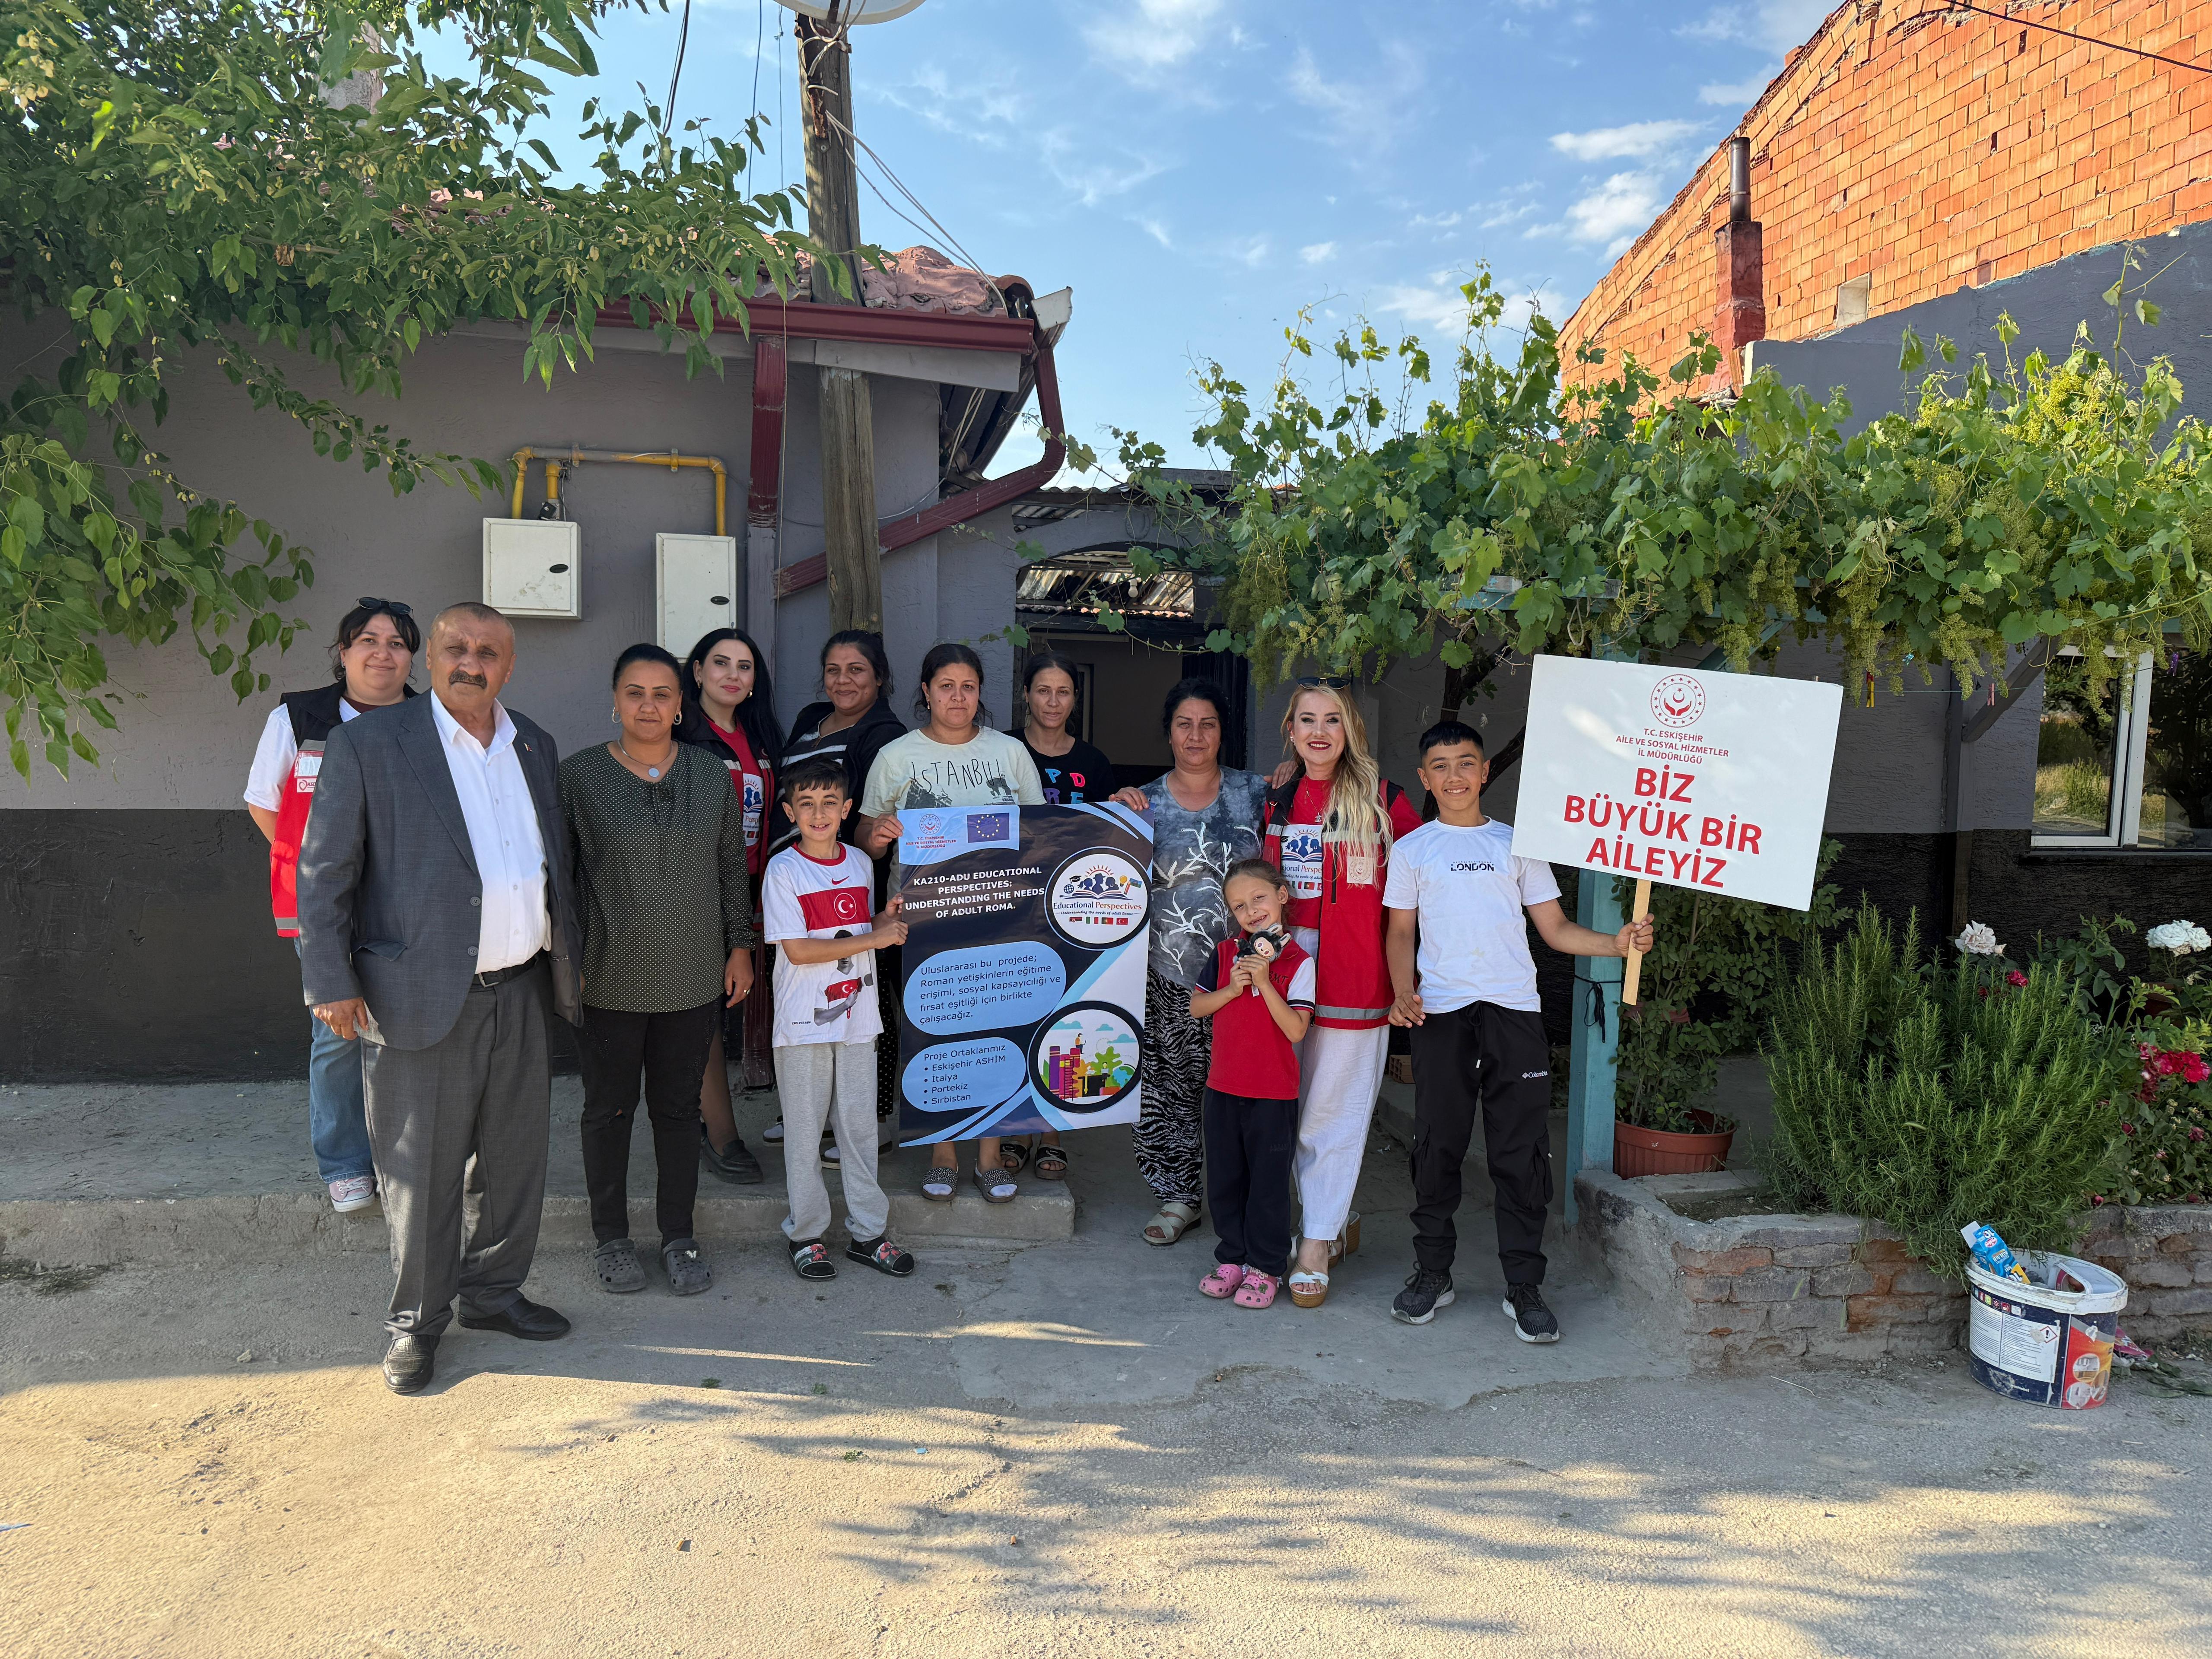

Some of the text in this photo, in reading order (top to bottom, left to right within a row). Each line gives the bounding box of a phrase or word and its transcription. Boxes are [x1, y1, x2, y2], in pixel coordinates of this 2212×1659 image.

[1659, 731, 1703, 742] ESKİŞEHİR
[1616, 735, 1633, 744] AİLE
[1647, 740, 1679, 750] SOSYAL
[1681, 744, 1729, 757] HİZMETLER
[1638, 748, 1702, 764] İL MÜDÜRLÜĞÜ
[1045, 769, 1085, 787] P D
[1635, 765, 1694, 803] BİZ
[1043, 788, 1059, 804] R
[1564, 793, 1761, 854] BÜYÜK BİR
[1451, 863, 1494, 871] LONDON
[1586, 835, 1726, 887] AİLEYİZ
[914, 867, 1042, 885] KA210-ADU EDUCATIONAL
[938, 880, 1012, 894] PERSPECTIVES:
[906, 894, 989, 910] UNDERSTANDING
[1014, 888, 1044, 897] NEEDS
[1053, 900, 1142, 910] Educational Perspectives
[952, 906, 982, 916] ADULT
[986, 903, 1015, 912] ROMA.
[922, 963, 976, 975] Uluslararası
[999, 955, 1036, 967] projede;
[921, 966, 1051, 987] Roman yetişkinlerin eğitime
[921, 988, 954, 999] erişimi,
[959, 984, 987, 994] sosyal
[992, 976, 1046, 990] kapsayıcılığı
[921, 992, 1032, 1011] fırsat eşitliği için birlikte
[920, 1011, 973, 1025] çalışacağız.
[925, 1046, 1005, 1061] Proje Ortaklarımız
[933, 1055, 1004, 1071] Eskişehir ASHİM
[932, 1074, 957, 1082] İtalya
[932, 1084, 967, 1093] Portekiz
[931, 1095, 970, 1104] Sırbistan
